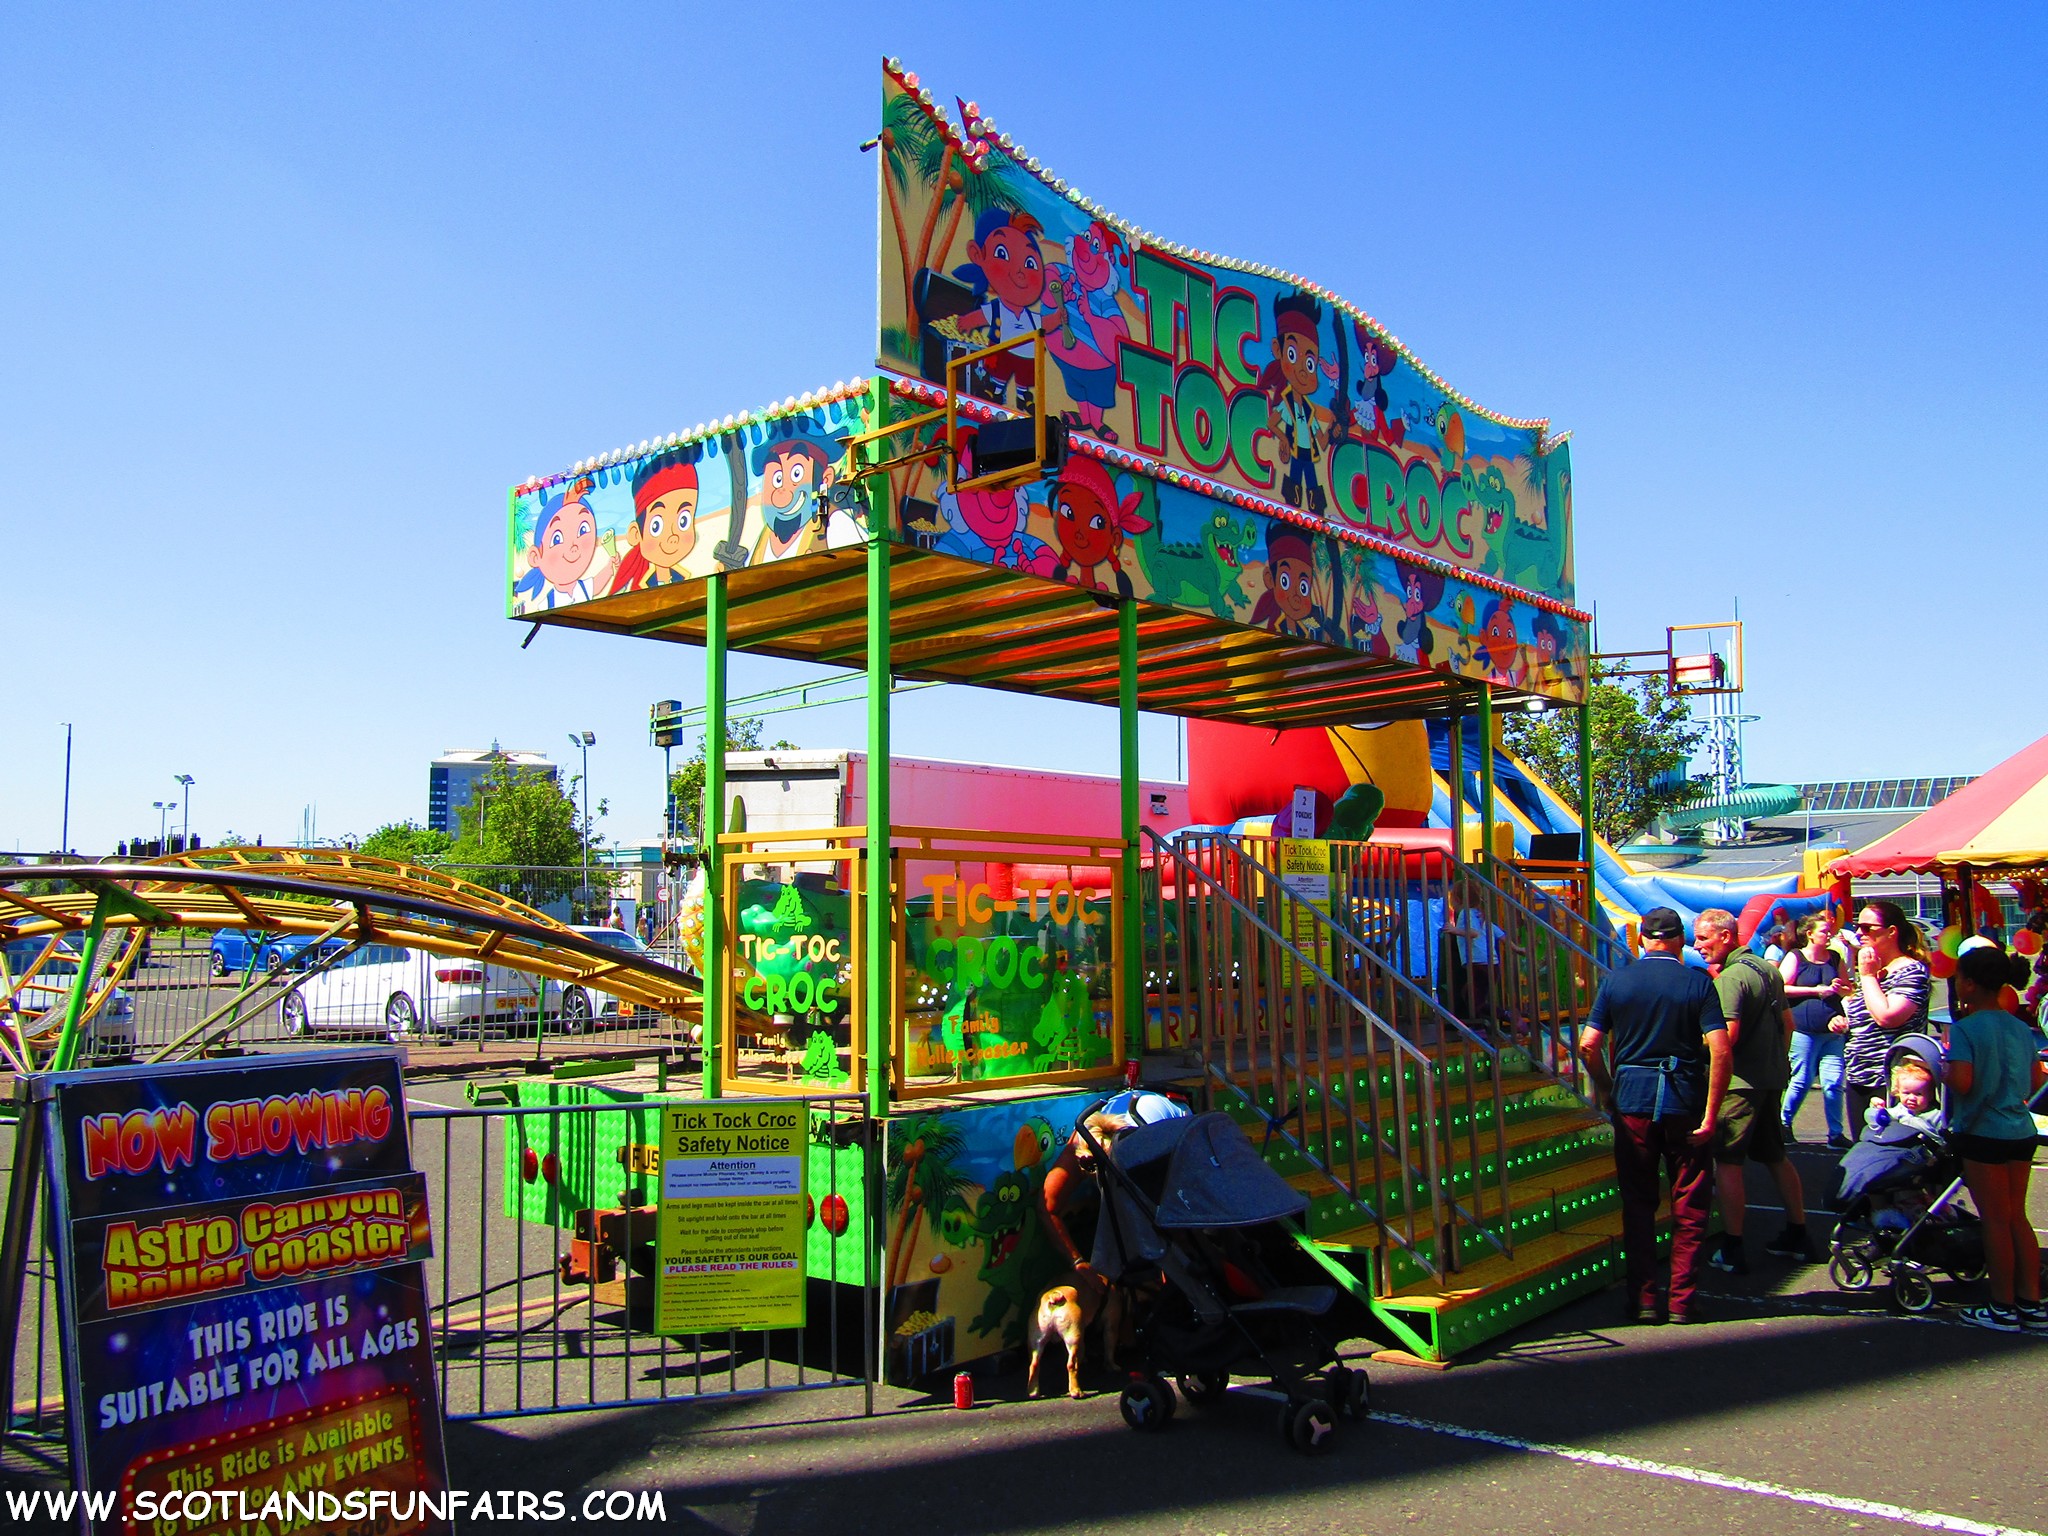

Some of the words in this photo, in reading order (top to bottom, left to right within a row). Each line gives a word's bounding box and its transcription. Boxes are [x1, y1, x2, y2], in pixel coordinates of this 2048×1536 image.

[1129, 244, 1260, 385] TIC
[1115, 335, 1274, 490] TOC
[1328, 432, 1474, 559] CROC
[1302, 796, 1307, 806] 2
[1283, 844, 1297, 856] Tick
[1299, 844, 1313, 856] Tock
[1313, 845, 1327, 857] Croc
[1286, 860, 1306, 873] Safety
[1307, 861, 1325, 871] Notice
[926, 935, 1045, 991] CROC
[742, 971, 838, 1016] CROC
[754, 1032, 787, 1049] Family
[948, 1010, 1000, 1035] Family
[916, 1041, 1029, 1067] Rollercoaster
[82, 1101, 199, 1181] NOW
[204, 1085, 393, 1163] SHOWING
[671, 1112, 707, 1130] Tick
[712, 1112, 752, 1129] Tock
[757, 1111, 797, 1128] Croc
[677, 1135, 732, 1156] Safety
[736, 1134, 790, 1151] Notice
[709, 1160, 756, 1171] Attention
[104, 1217, 238, 1271] Astro
[241, 1188, 404, 1246] Canyon
[664, 1256, 692, 1265] YOUR
[694, 1254, 733, 1264] SAFETY
[735, 1253, 746, 1262] IS
[749, 1252, 769, 1262] OUR
[771, 1251, 798, 1261] GOAL
[668, 1264, 707, 1274] PLEASE
[709, 1263, 737, 1272] READ
[739, 1262, 759, 1271] THE
[761, 1260, 794, 1270] RULES
[106, 1254, 249, 1310] Roller
[188, 1316, 251, 1361] THIS
[258, 1302, 318, 1344] RIDE
[325, 1295, 349, 1328] IS
[99, 1363, 241, 1429] SUITABLE
[249, 1349, 300, 1390] FOR
[306, 1336, 354, 1375] ALL
[360, 1318, 421, 1360] AGES
[167, 1462, 214, 1497] This
[221, 1449, 271, 1483] Ride
[277, 1438, 295, 1465] is
[302, 1409, 393, 1457] Available
[280, 1459, 328, 1499] ANY
